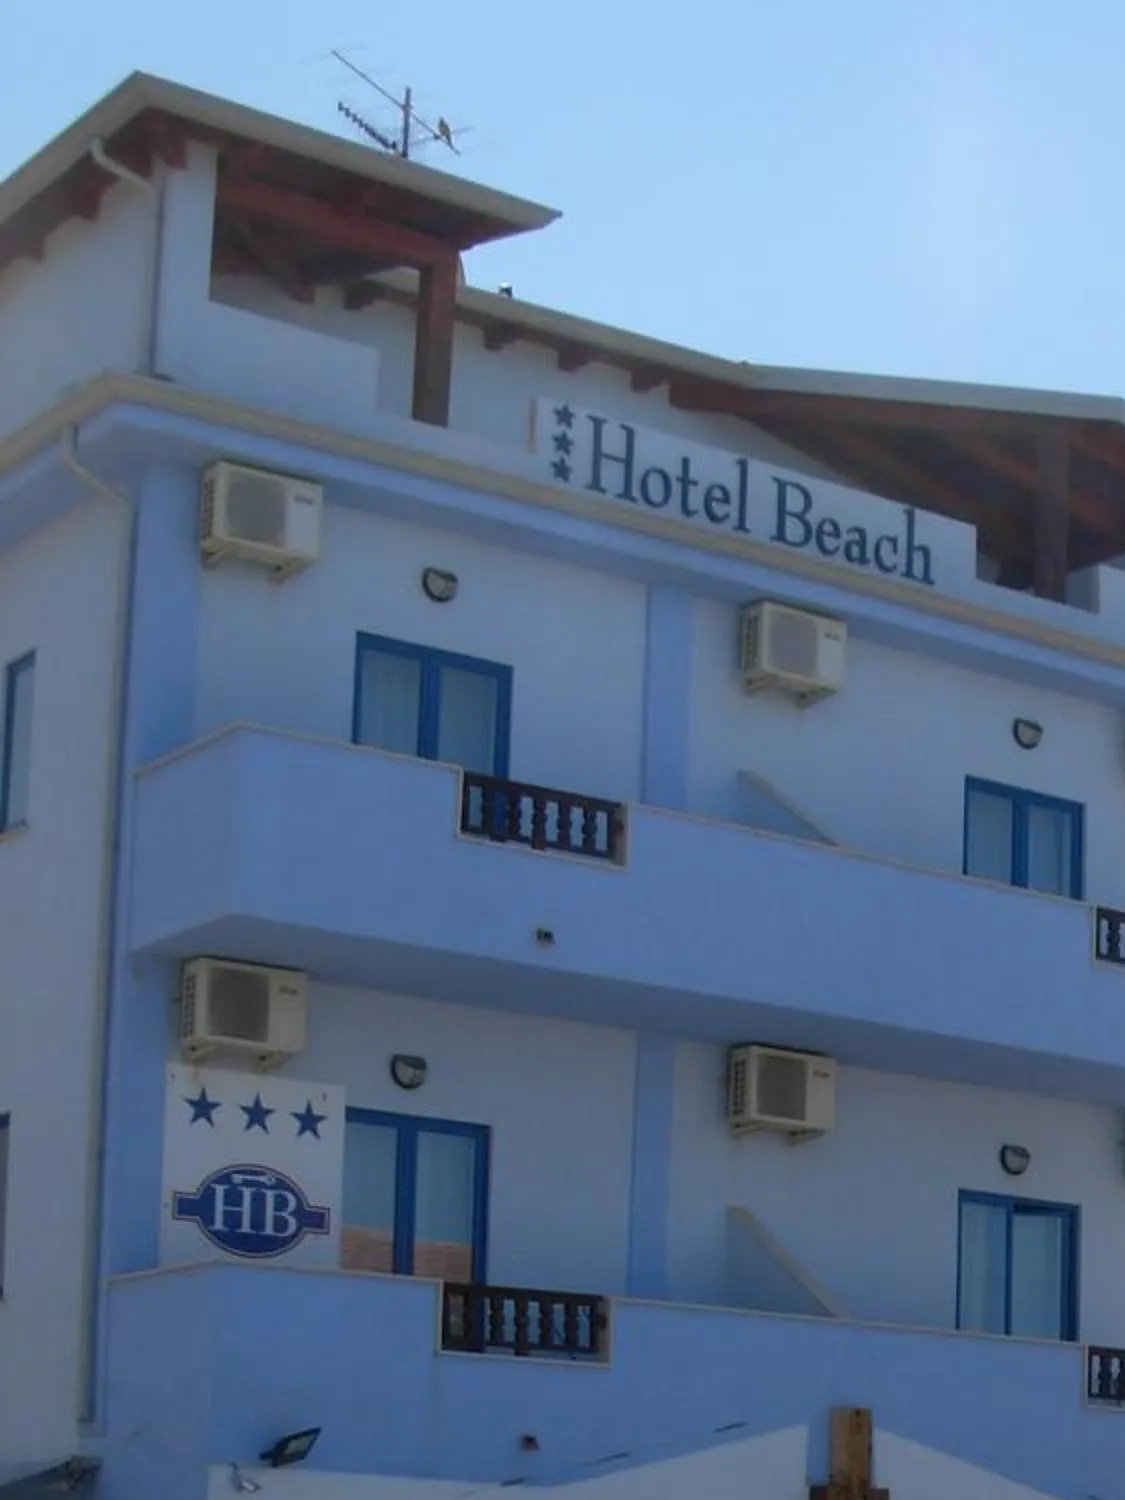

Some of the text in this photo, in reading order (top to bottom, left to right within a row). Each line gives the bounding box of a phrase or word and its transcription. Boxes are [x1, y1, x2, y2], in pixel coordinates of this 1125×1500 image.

[585, 414, 935, 586] Hotel Beach
[208, 1183, 300, 1237] HB
